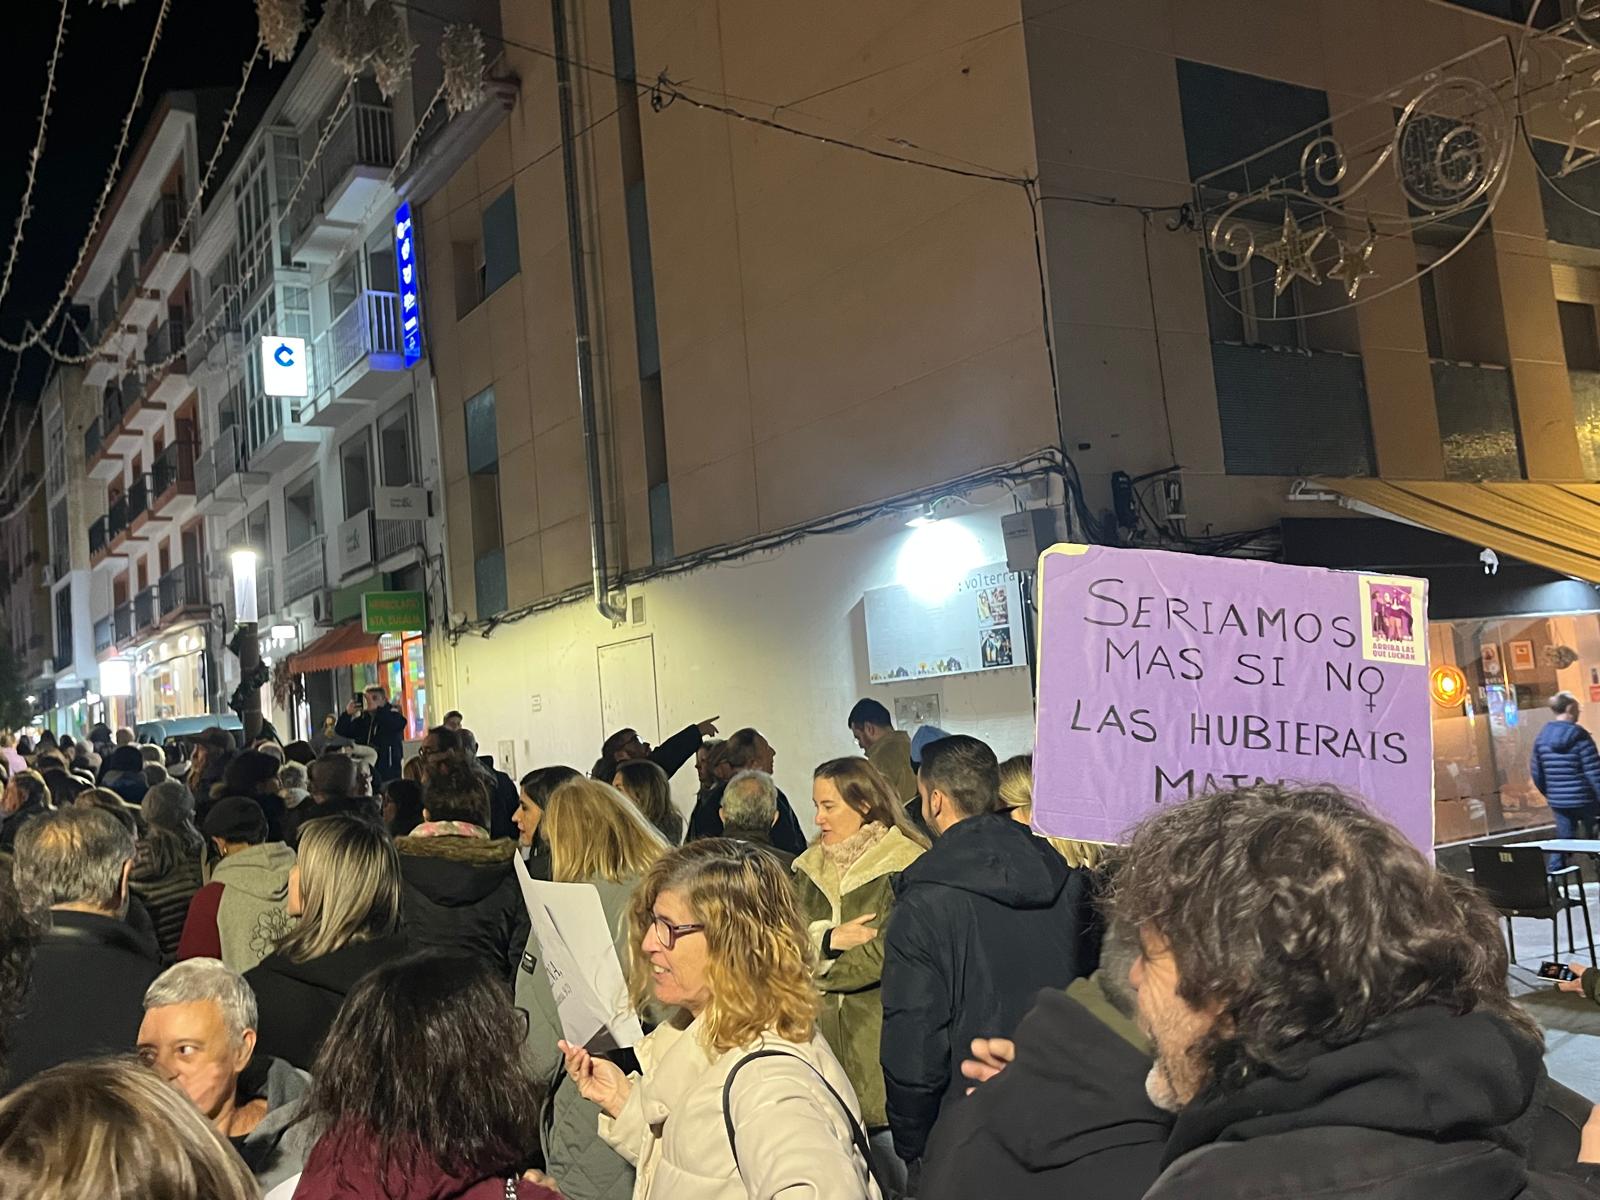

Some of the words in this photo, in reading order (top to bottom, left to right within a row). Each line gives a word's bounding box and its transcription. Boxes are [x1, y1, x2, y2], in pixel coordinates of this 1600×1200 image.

[964, 572, 1015, 590] volterra
[1083, 578, 1357, 648] SERIAMOS
[1372, 642, 1400, 652] ARRIBA
[1401, 644, 1415, 654] LAS
[1372, 649, 1387, 658] QUE
[1387, 650, 1416, 661] LUCHAN
[1104, 637, 1204, 680] MAS
[1234, 653, 1286, 687] SI
[1325, 661, 1385, 713] NO
[1070, 699, 1158, 743] LAS
[1190, 712, 1408, 764] HUBIERAIS
